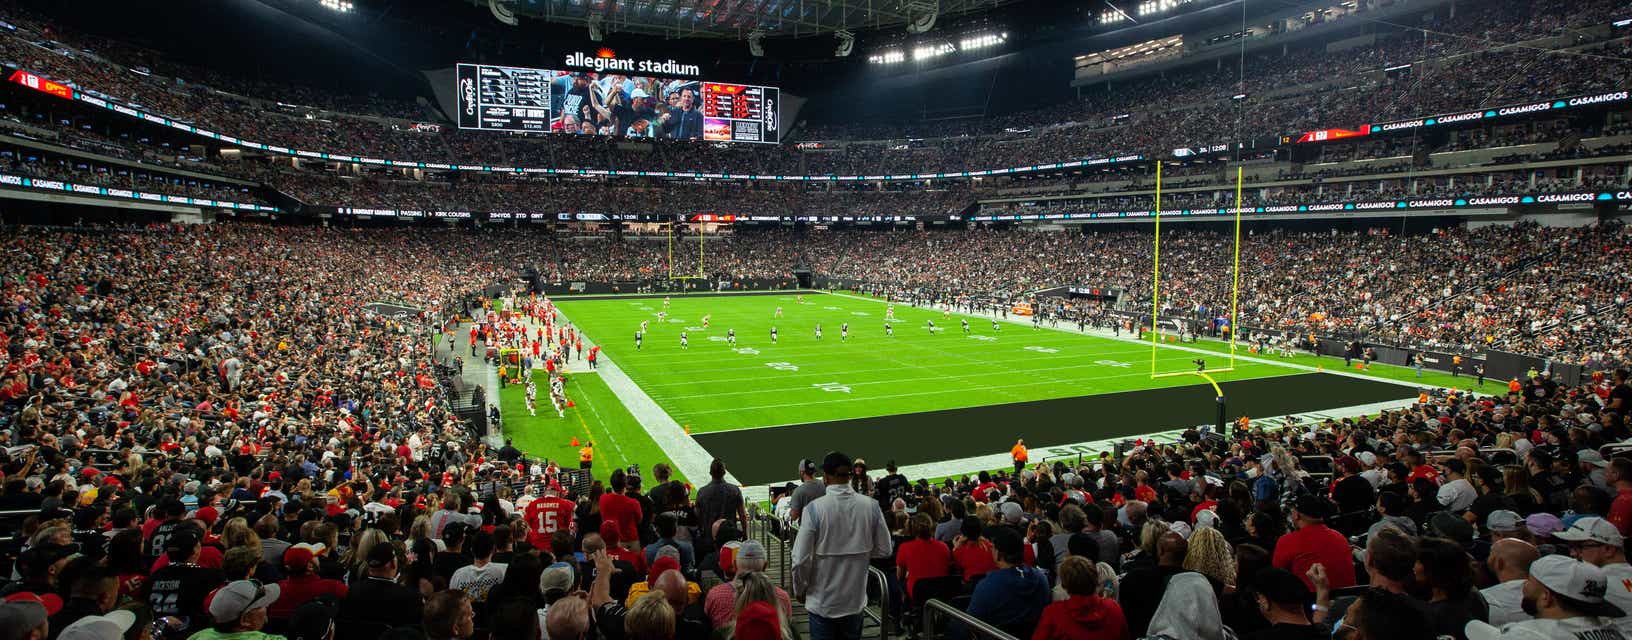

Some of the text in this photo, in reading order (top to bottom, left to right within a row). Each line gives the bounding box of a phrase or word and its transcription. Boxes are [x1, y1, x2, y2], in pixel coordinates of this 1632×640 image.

[565, 52, 699, 75] allegiant stadium
[1383, 91, 1629, 131] CASAMIGOS CASAMIGOS CASAMIGOS CASAMIGOS
[1469, 197, 1519, 205] CASAMIGOS
[1537, 193, 1595, 202] CASAMIGOS
[537, 511, 558, 534] 15
